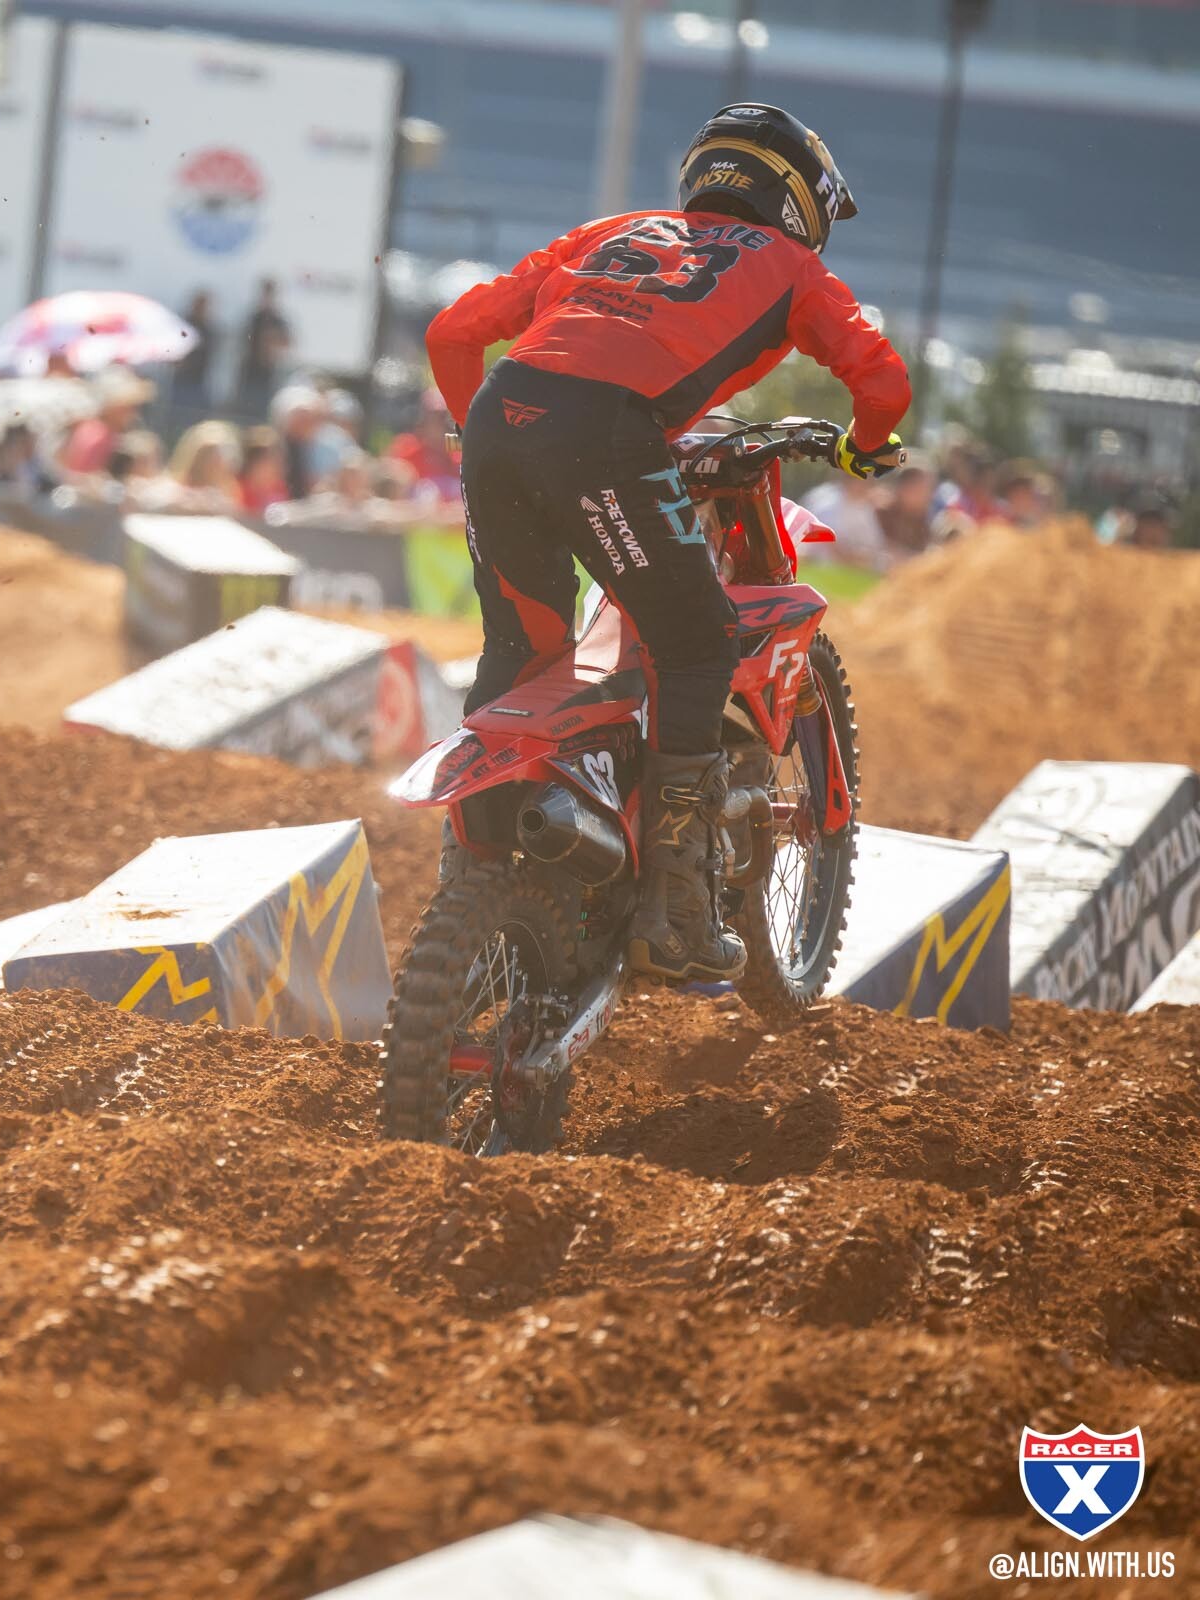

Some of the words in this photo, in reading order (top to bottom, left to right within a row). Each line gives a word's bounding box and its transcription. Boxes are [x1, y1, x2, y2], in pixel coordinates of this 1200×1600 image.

[710, 161, 739, 170] MAX
[571, 236, 740, 302] 63
[588, 515, 625, 576] HONDA
[601, 489, 625, 520] FIRE
[613, 520, 649, 567] POWER
